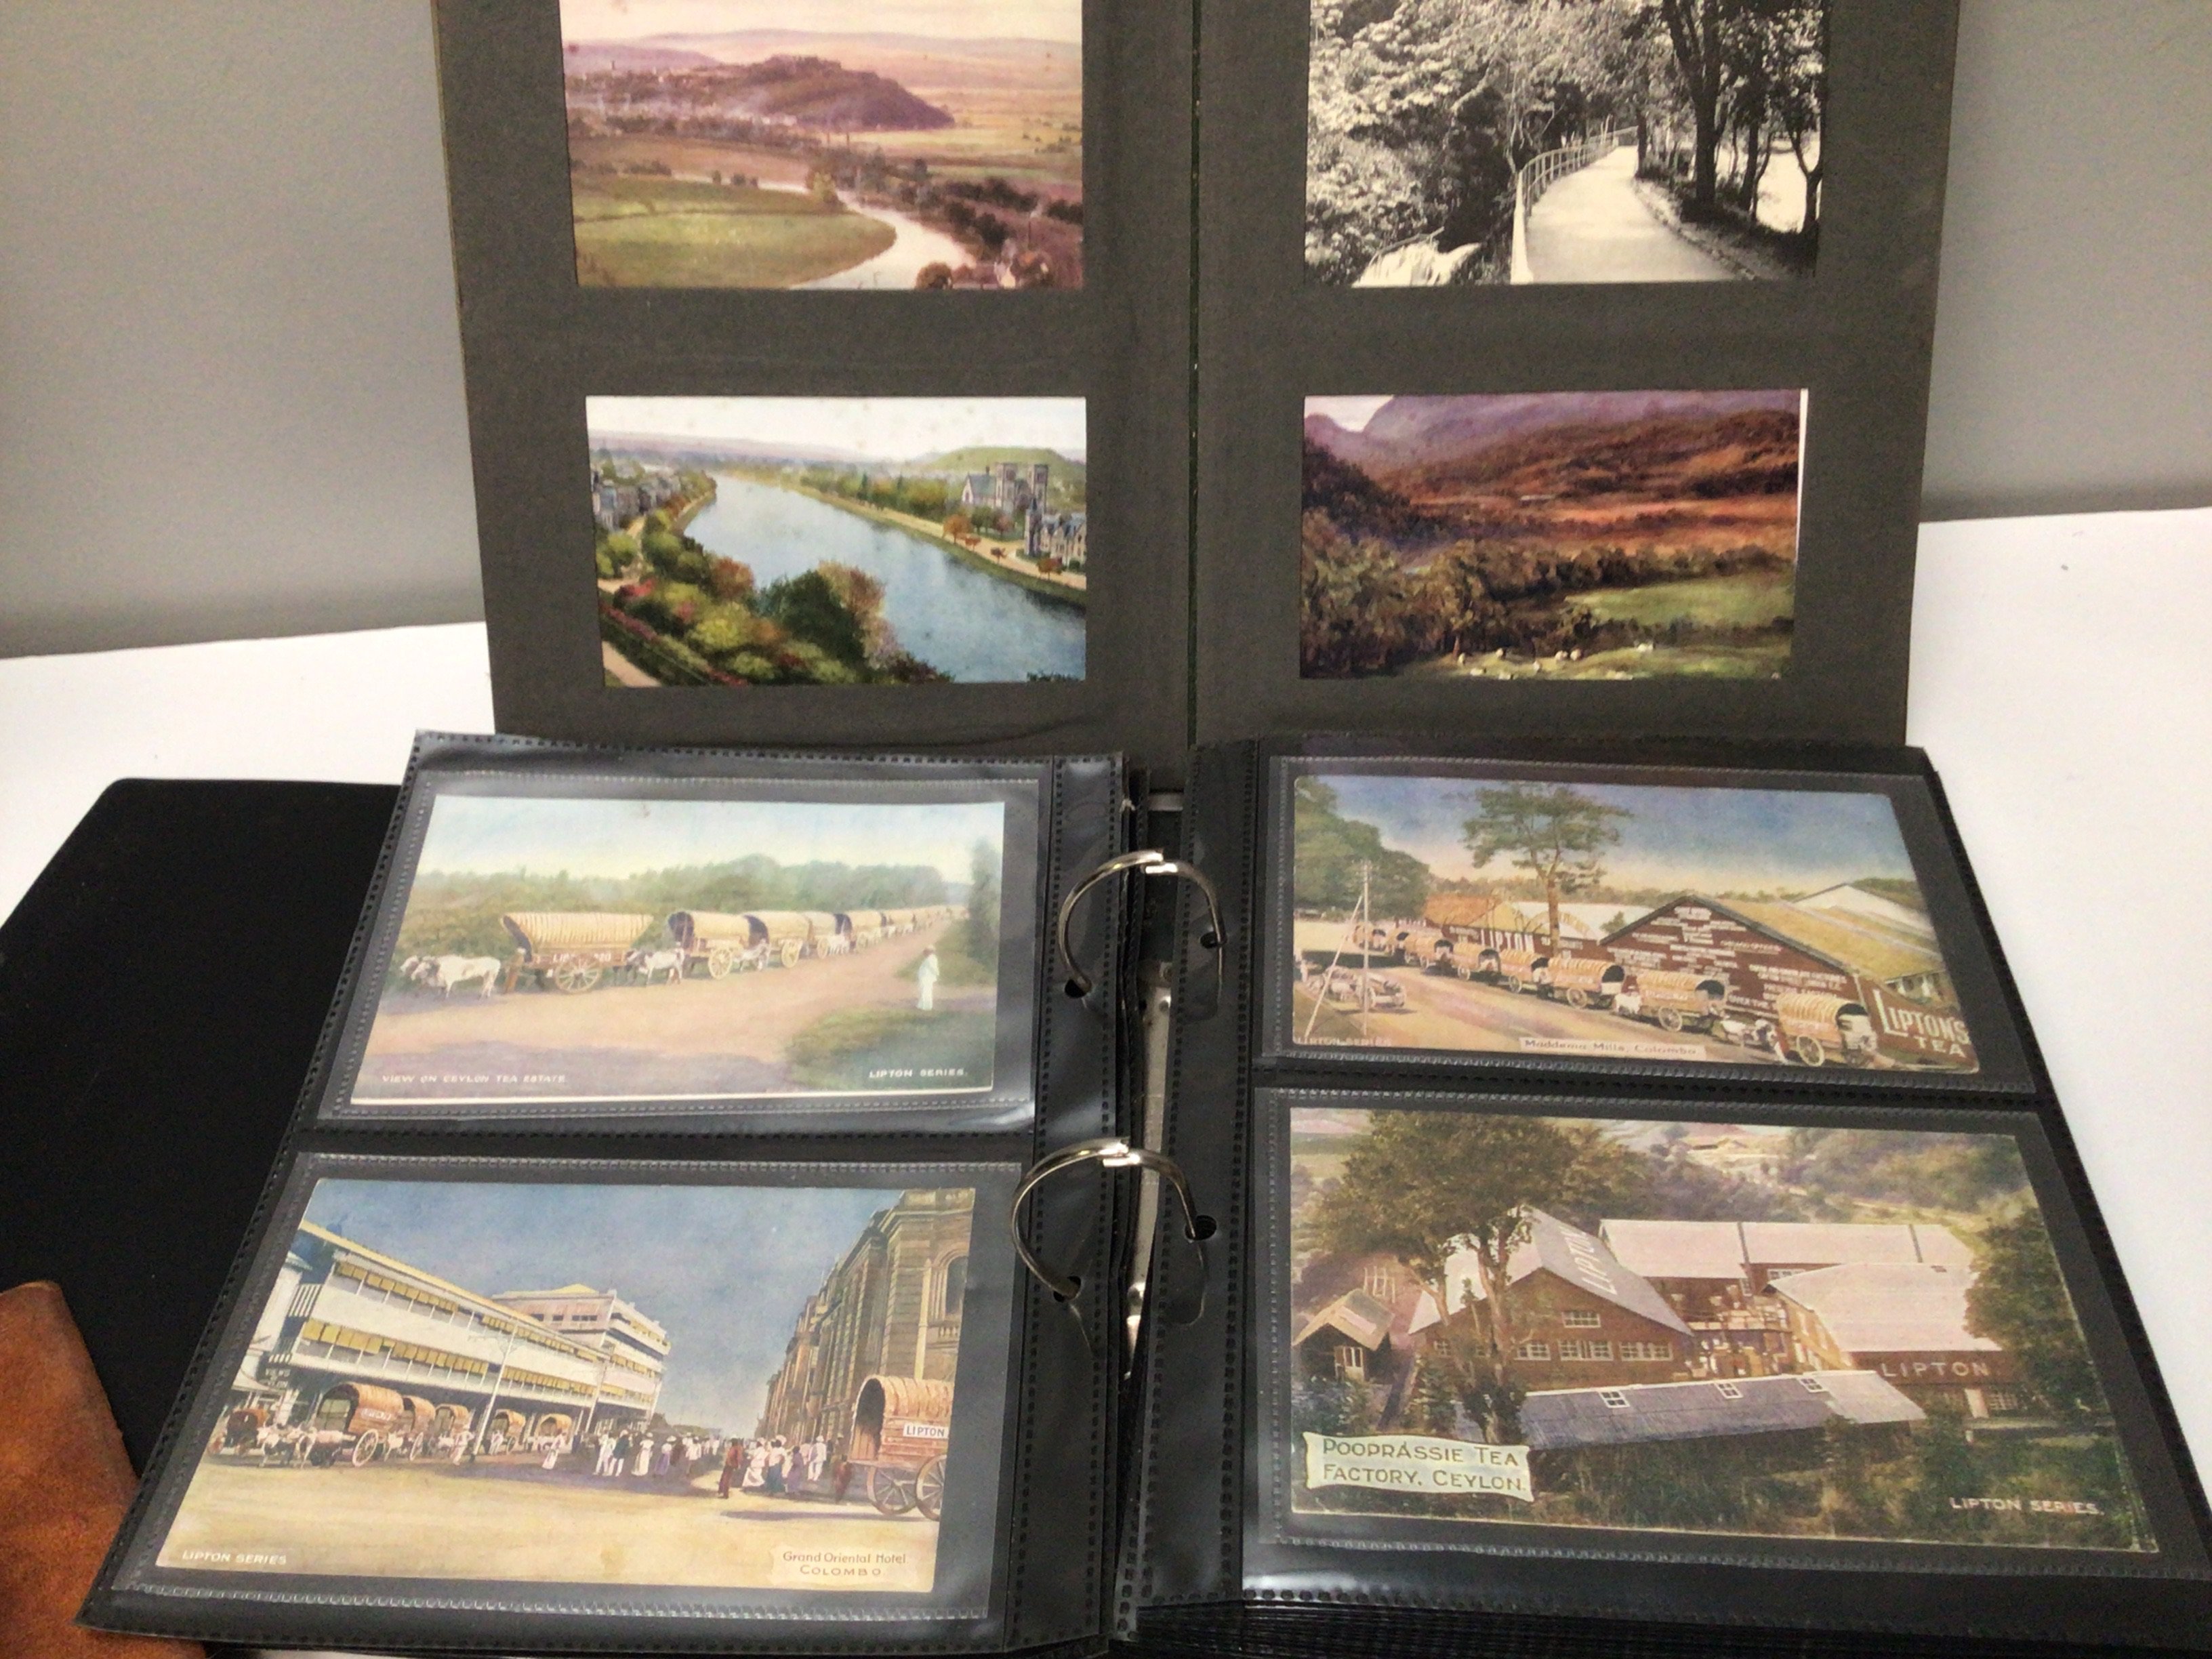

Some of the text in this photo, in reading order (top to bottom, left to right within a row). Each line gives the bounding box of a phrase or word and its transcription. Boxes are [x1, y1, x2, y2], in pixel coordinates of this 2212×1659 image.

[382, 1075, 415, 1084] VIEW
[443, 1074, 489, 1084] CEYLON
[495, 1074, 518, 1084] TEA
[869, 1069, 913, 1078] LIPTON
[1881, 1361, 1991, 1378] LIPTON
[906, 1425, 945, 1437] LIPTON
[1473, 1446, 1519, 1467] TEA
[1949, 1496, 2022, 1511] LIPTON
[182, 1549, 287, 1565] LIPTON SERIES
[782, 1551, 907, 1564] Grand Oriental Hotel
[800, 1564, 882, 1576] COLOMBO
